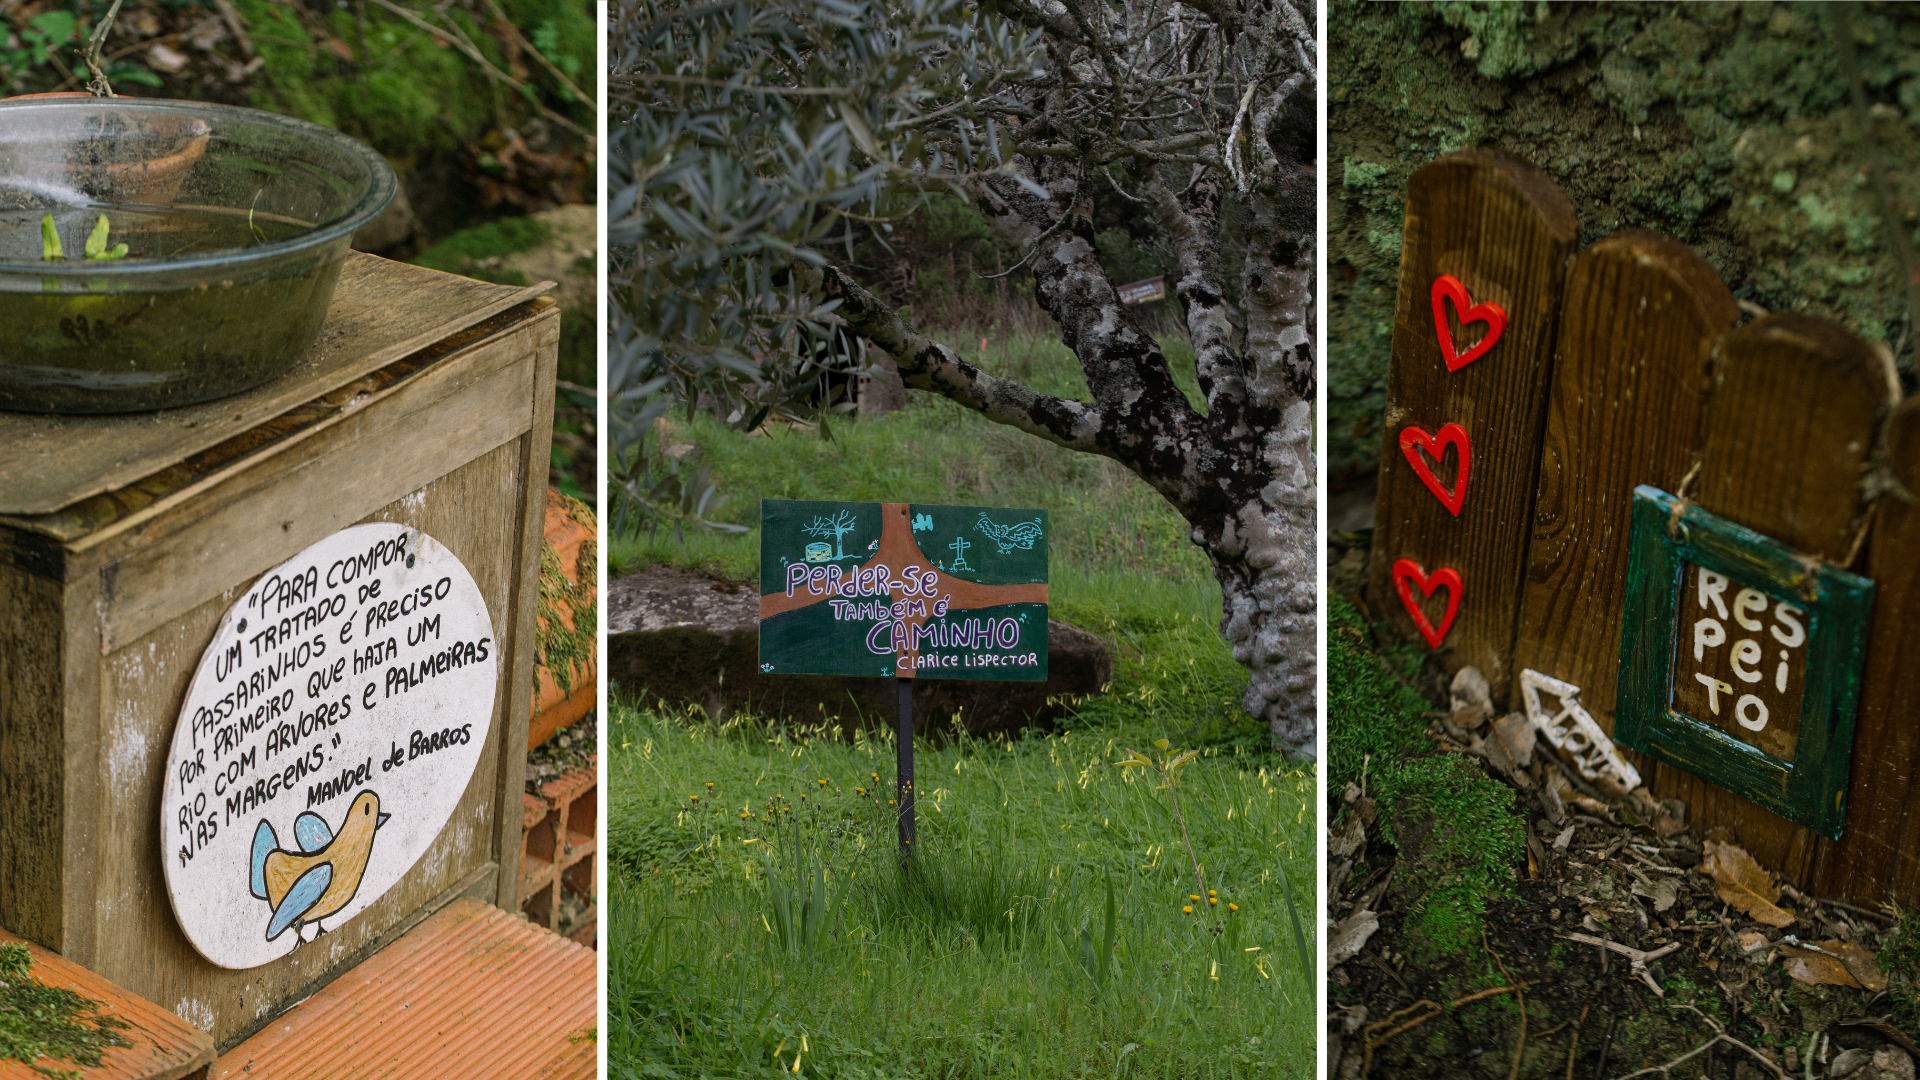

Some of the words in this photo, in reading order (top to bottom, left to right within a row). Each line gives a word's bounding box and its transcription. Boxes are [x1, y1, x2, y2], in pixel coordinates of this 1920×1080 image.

[248, 565, 318, 620] "PARA
[326, 532, 407, 589] COMPOR
[216, 639, 242, 682] UM
[249, 594, 346, 658] TRATADO
[179, 748, 206, 796] POR
[407, 614, 441, 647] UM
[215, 745, 256, 796] COM
[382, 741, 404, 772] de
[408, 723, 472, 761] BARROS
[179, 811, 217, 868] NAS
